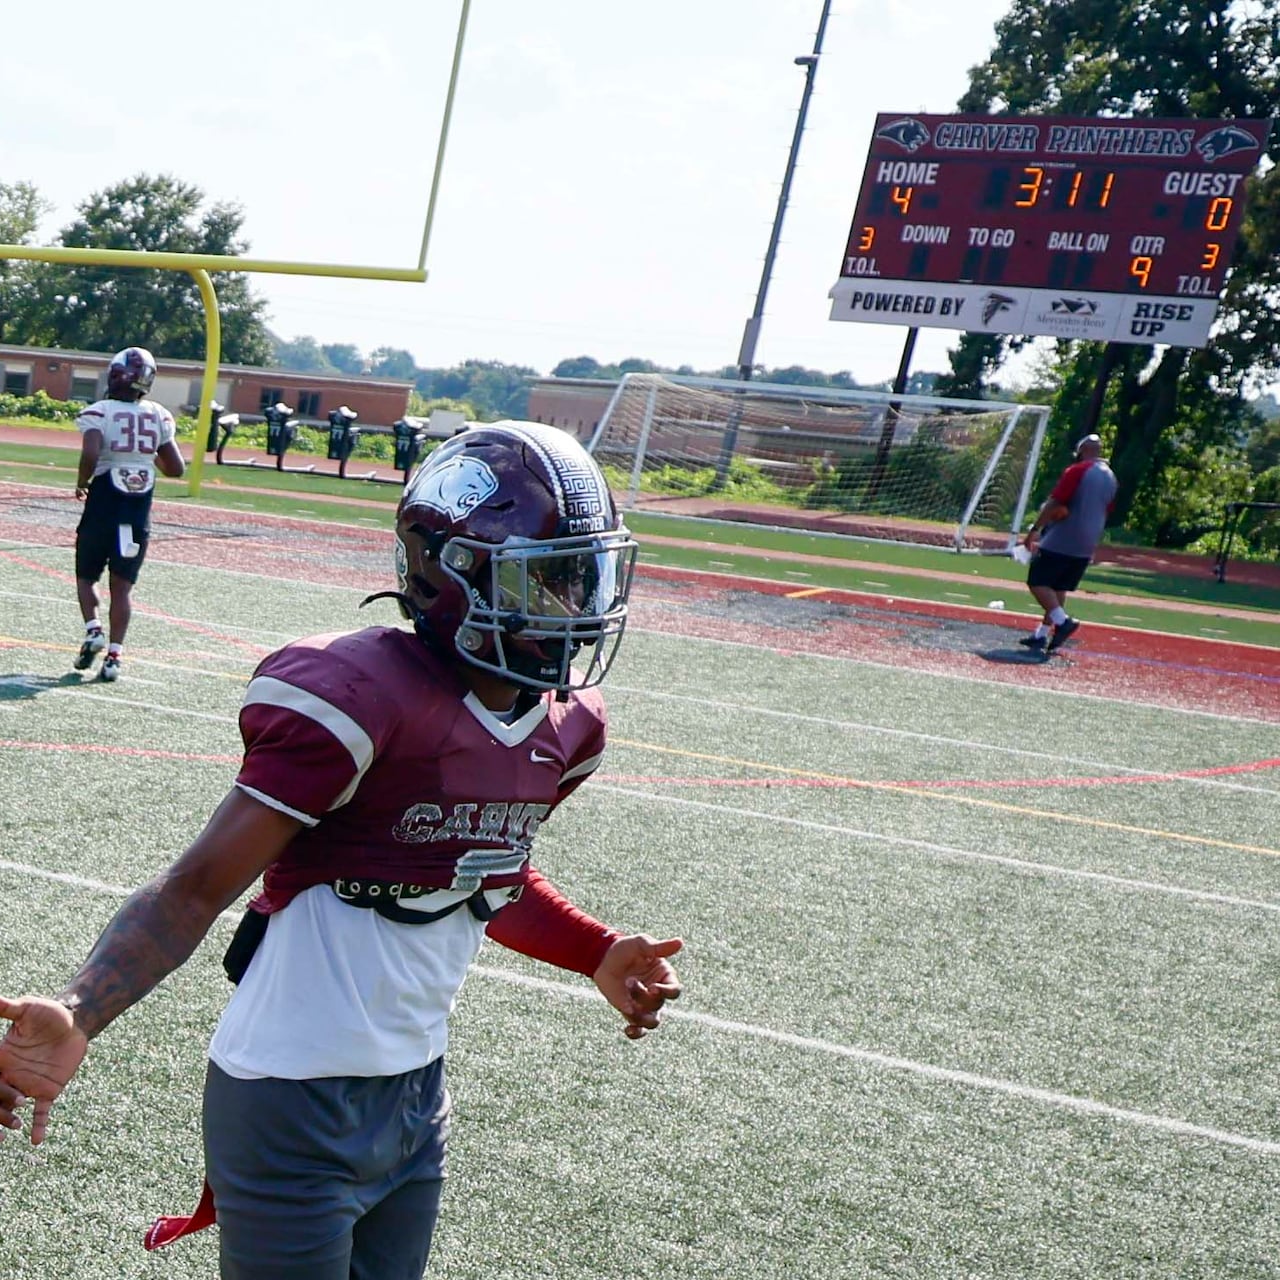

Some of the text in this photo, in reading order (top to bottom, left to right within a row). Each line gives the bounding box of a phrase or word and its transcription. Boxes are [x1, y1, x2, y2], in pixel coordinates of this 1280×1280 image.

[935, 122, 1195, 157] CARVER PANTHERS
[876, 161, 939, 184] HOME
[1164, 171, 1243, 196] GUEST
[1015, 167, 1115, 208] 3:11
[893, 187, 913, 214] 4
[1206, 197, 1233, 231] 0
[859, 226, 876, 250] 3
[901, 224, 950, 245] DOWN
[968, 227, 1015, 247] TO GO
[1048, 231, 1109, 252] BALL ON
[1130, 235, 1165, 255] QTR
[845, 257, 880, 275] T.O.L.
[1200, 243, 1220, 269] 3
[1131, 256, 1153, 287] 9
[1176, 275, 1216, 295] T.O.L.
[851, 291, 966, 316] POWERED BY
[1134, 302, 1194, 321] RISE
[1130, 321, 1165, 337] UP
[111, 411, 158, 454] 35
[569, 516, 605, 534] CARVER
